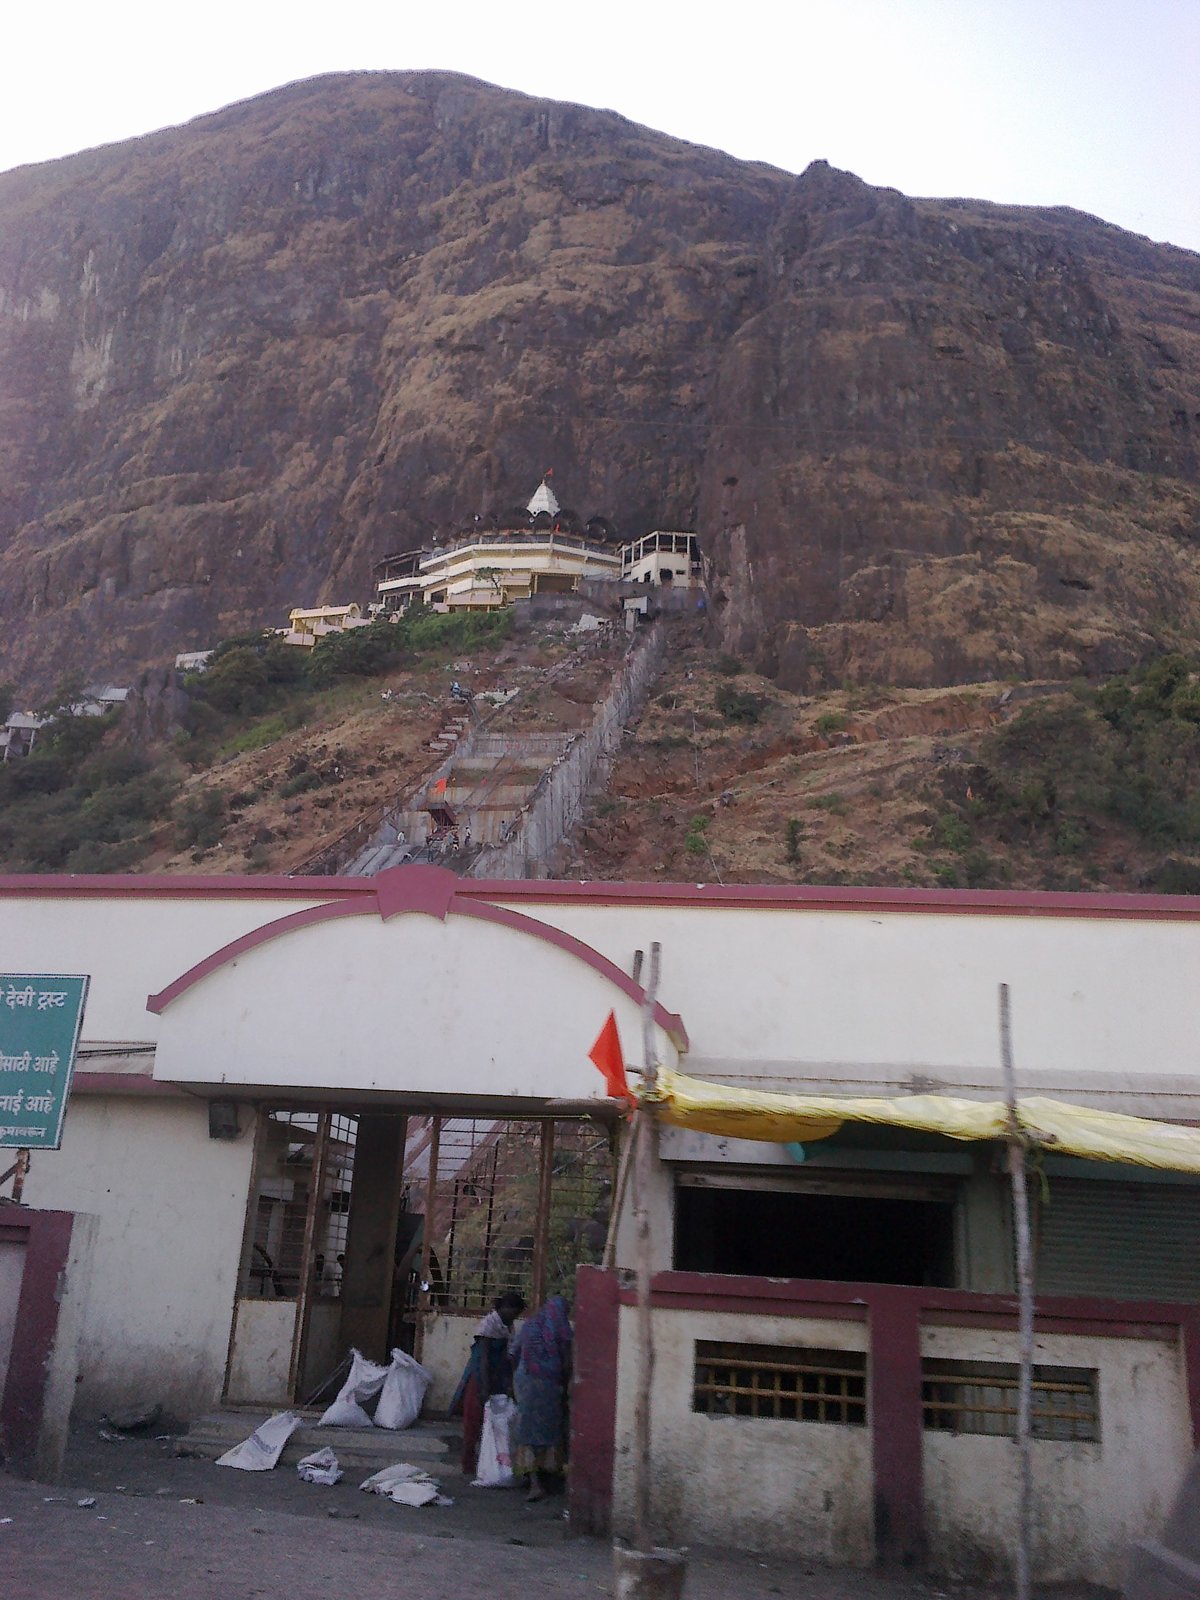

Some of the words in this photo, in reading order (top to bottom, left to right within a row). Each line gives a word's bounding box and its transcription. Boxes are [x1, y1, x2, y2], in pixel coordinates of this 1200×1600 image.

[6, 984, 36, 1010] देवी
[37, 991, 68, 1011] ट्रस्ट
[33, 1050, 60, 1075] आहे
[25, 1089, 56, 1114] आहे
